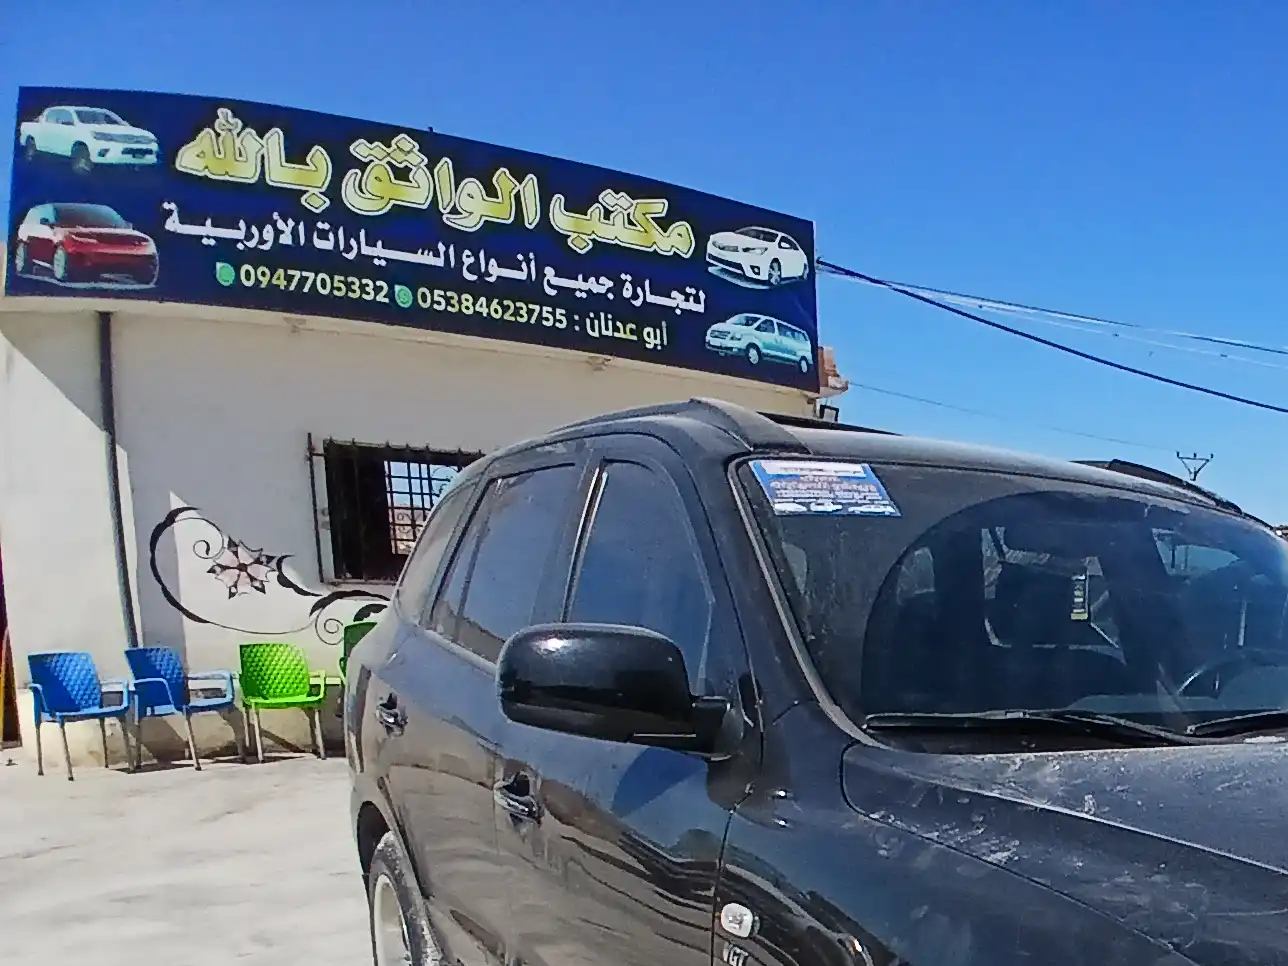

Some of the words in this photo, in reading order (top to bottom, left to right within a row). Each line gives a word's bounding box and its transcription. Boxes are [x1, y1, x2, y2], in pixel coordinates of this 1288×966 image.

[175, 108, 332, 213] بالله
[341, 133, 540, 232] الواثق
[162, 201, 306, 250] الأوربية
[312, 220, 455, 268] السيارات
[549, 189, 696, 258] مكتب
[239, 263, 390, 304] 0947705332
[462, 249, 536, 283] أنواع
[543, 264, 614, 299] جميع
[416, 286, 568, 330] 05384623755
[622, 271, 706, 315] لتجارة
[585, 311, 638, 341] عدنان
[642, 320, 668, 350] أبو
